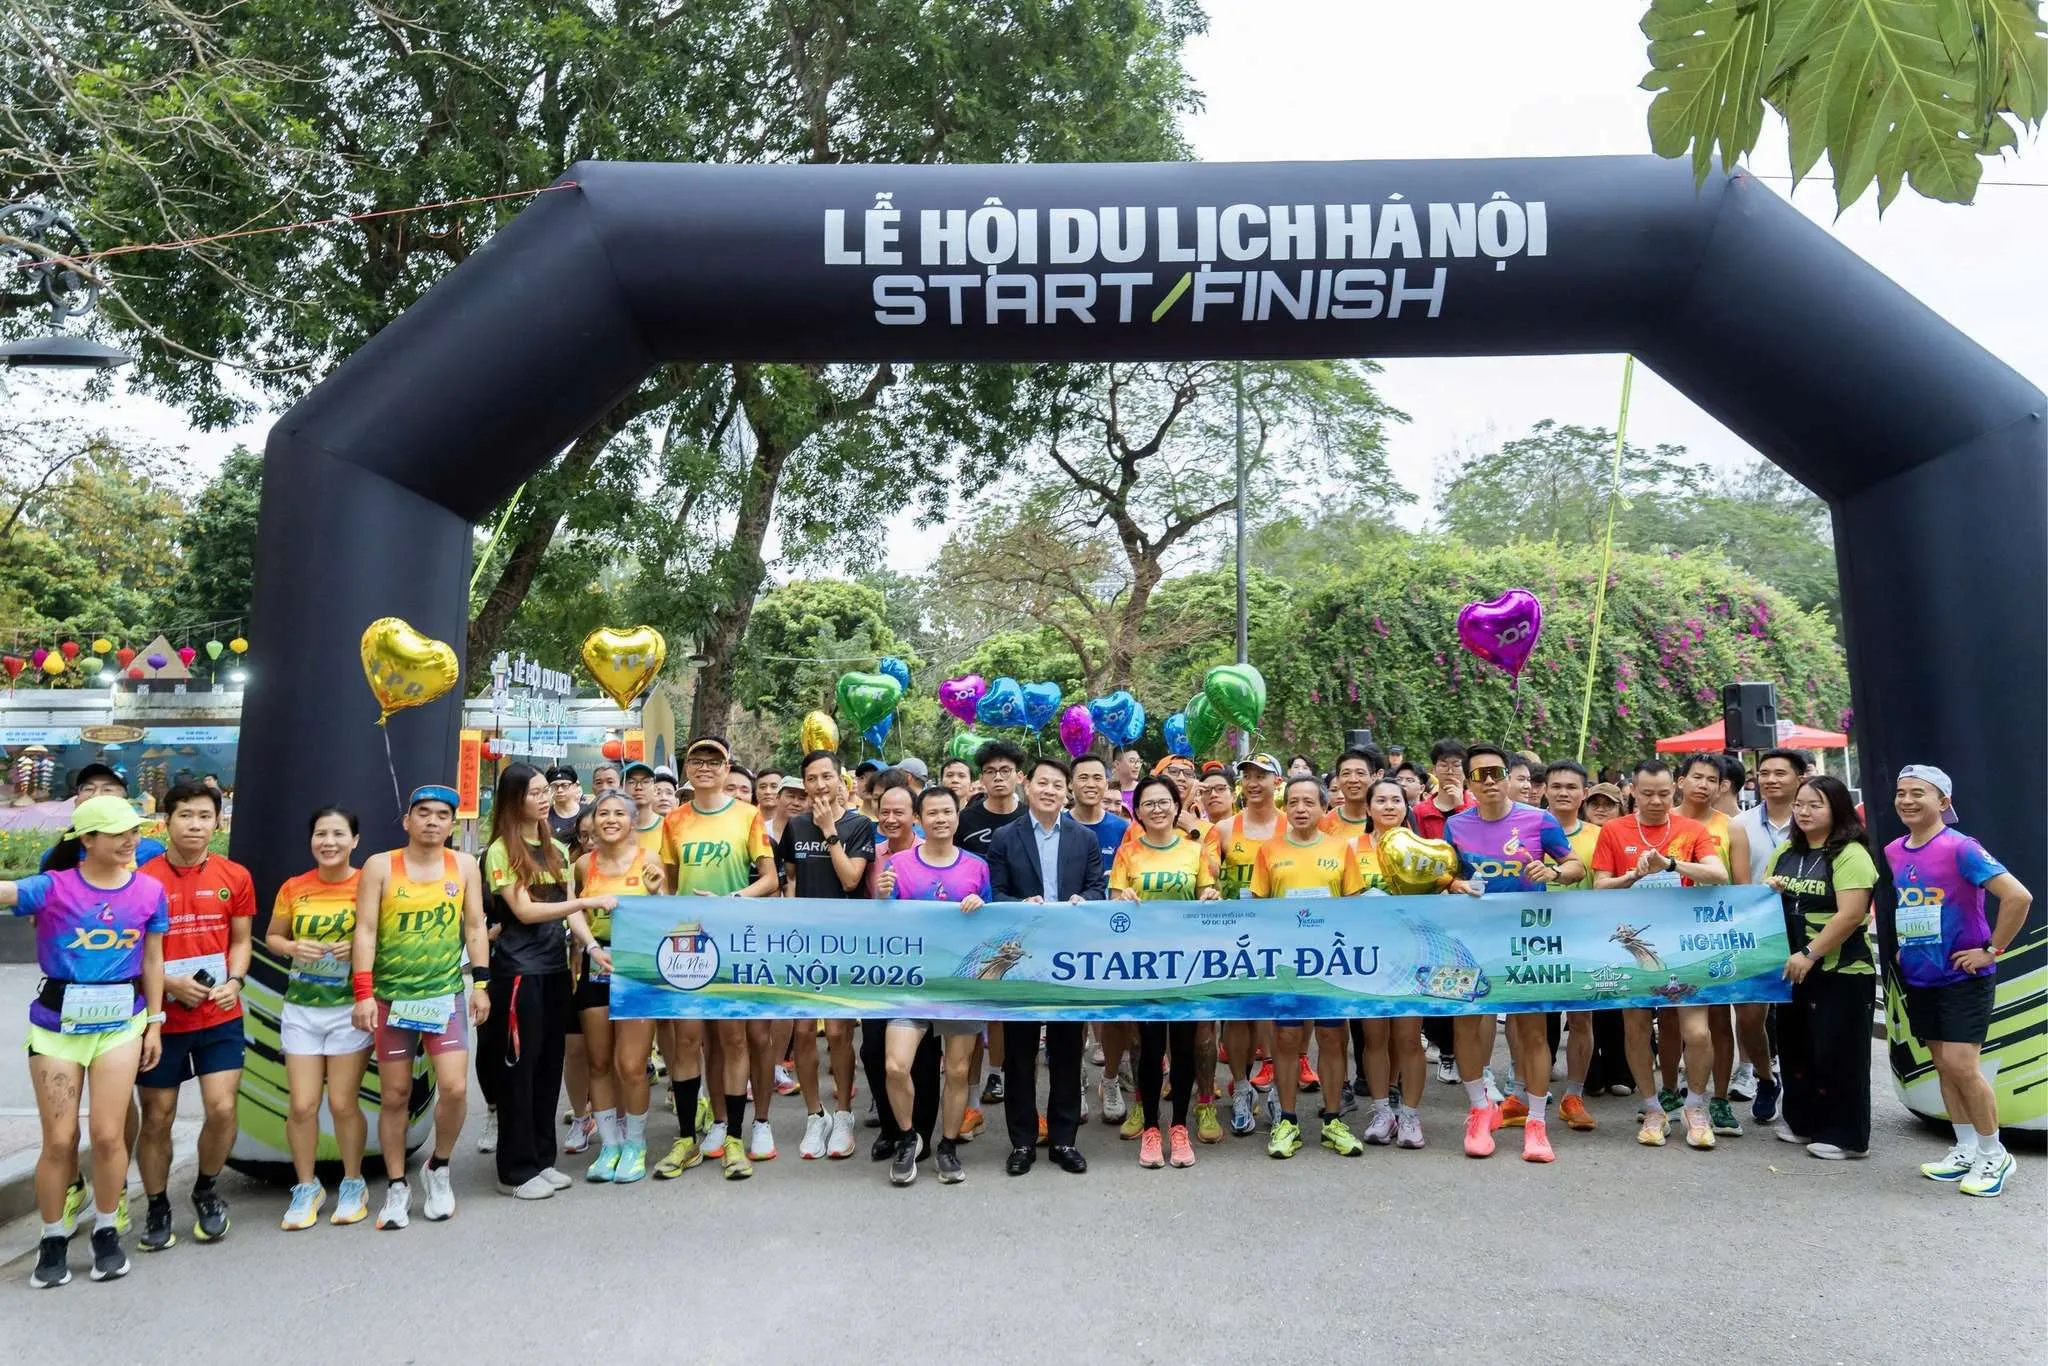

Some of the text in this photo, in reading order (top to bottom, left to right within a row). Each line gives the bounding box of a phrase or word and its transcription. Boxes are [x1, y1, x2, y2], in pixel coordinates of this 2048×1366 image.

[824, 192, 903, 265] LỄ
[920, 196, 1038, 276] HỘI
[1049, 206, 1147, 264] DU
[1157, 203, 1316, 273] LỊCH
[1428, 190, 1548, 272] NỘI
[1494, 620, 1531, 648] XOR
[1521, 908, 1552, 928] DU
[1693, 900, 1734, 923] TRẢI
[66, 927, 140, 950] XOR
[730, 925, 923, 959] LỄ HỘI DU LỊCH
[1510, 935, 1563, 962] LỊCH
[1679, 928, 1757, 953] NGHIỆM
[1293, 931, 1380, 977] ĐẦU
[1708, 954, 1738, 979] SỐ
[732, 958, 924, 991] HÀ NỘI 2026
[1504, 963, 1572, 985] XANH
